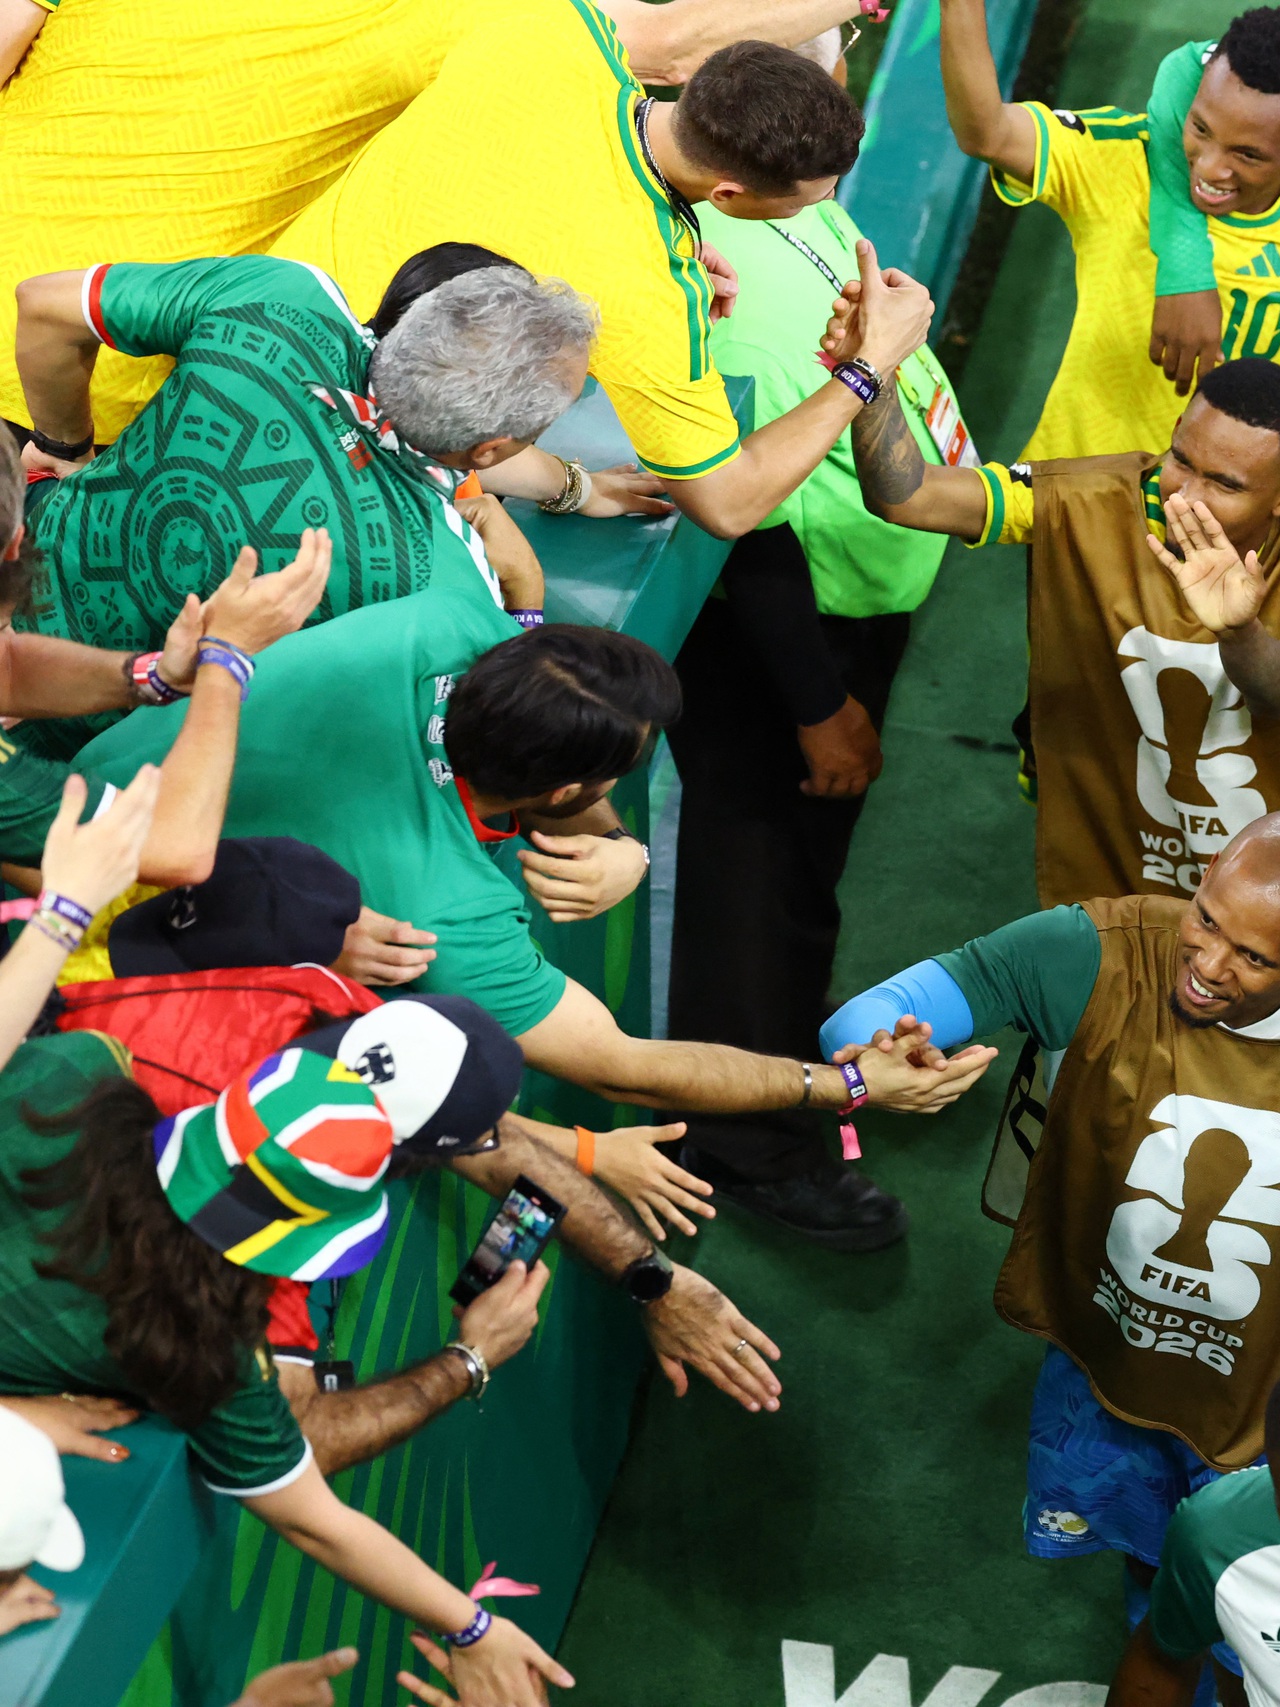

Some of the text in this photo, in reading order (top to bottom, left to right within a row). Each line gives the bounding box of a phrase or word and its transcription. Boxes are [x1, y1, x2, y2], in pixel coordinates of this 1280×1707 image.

[841, 369, 857, 384] KOR
[843, 1063, 858, 1082] KOR
[1139, 1263, 1212, 1303] FIFA
[1100, 1267, 1244, 1349] WORLD CUP
[1092, 1284, 1235, 1377] 2026
